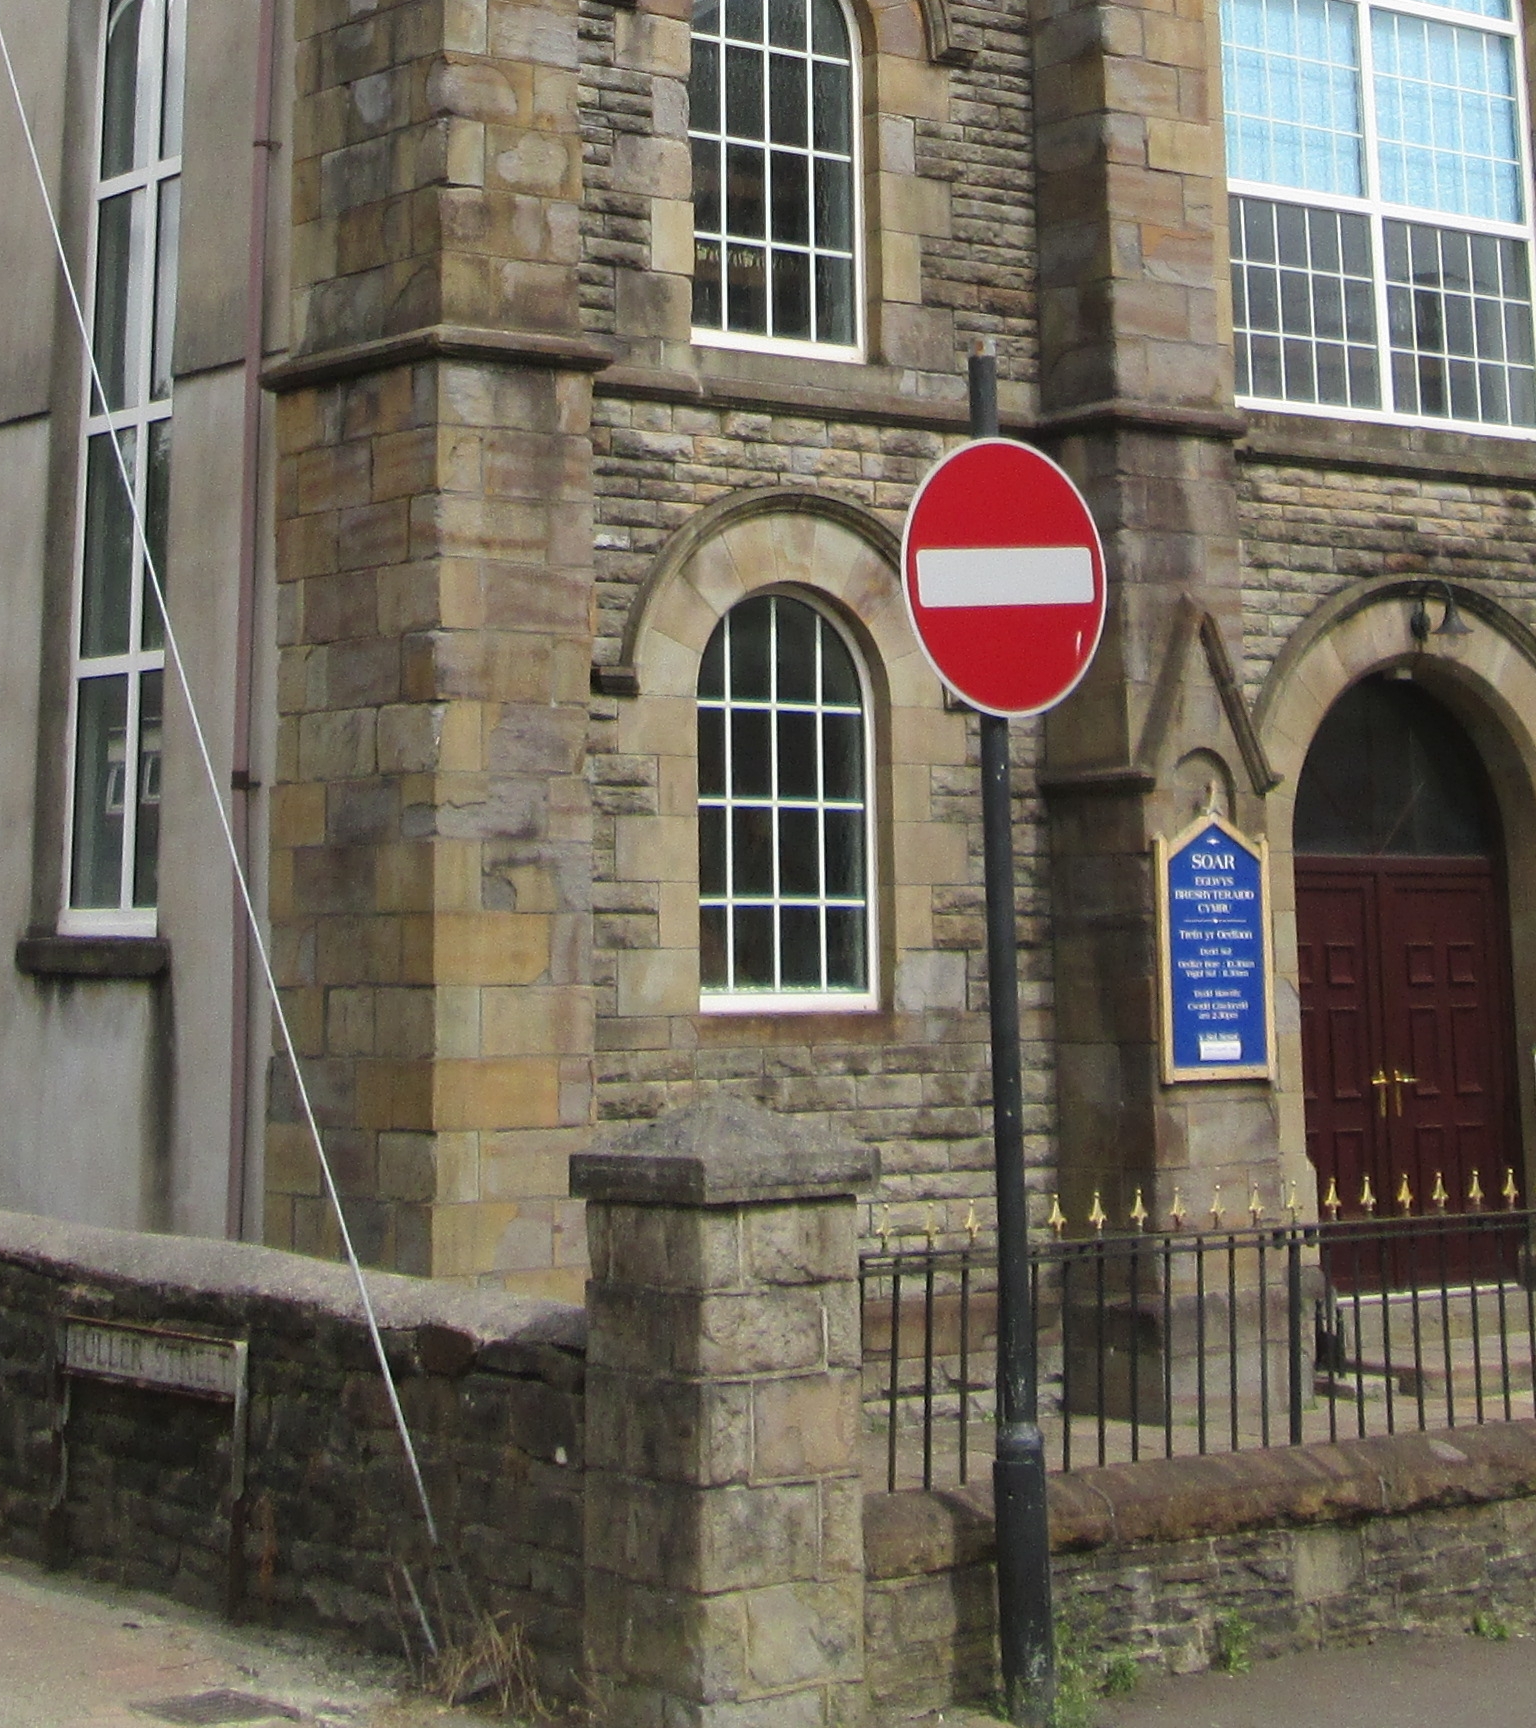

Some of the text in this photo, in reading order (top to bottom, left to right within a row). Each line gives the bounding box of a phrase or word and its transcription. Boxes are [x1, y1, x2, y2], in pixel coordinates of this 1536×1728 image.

[1191, 853, 1236, 870] SOAR
[1194, 876, 1234, 887] EGLWYS
[1197, 903, 1231, 914] CYMRU
[1204, 932, 1214, 941] yr
